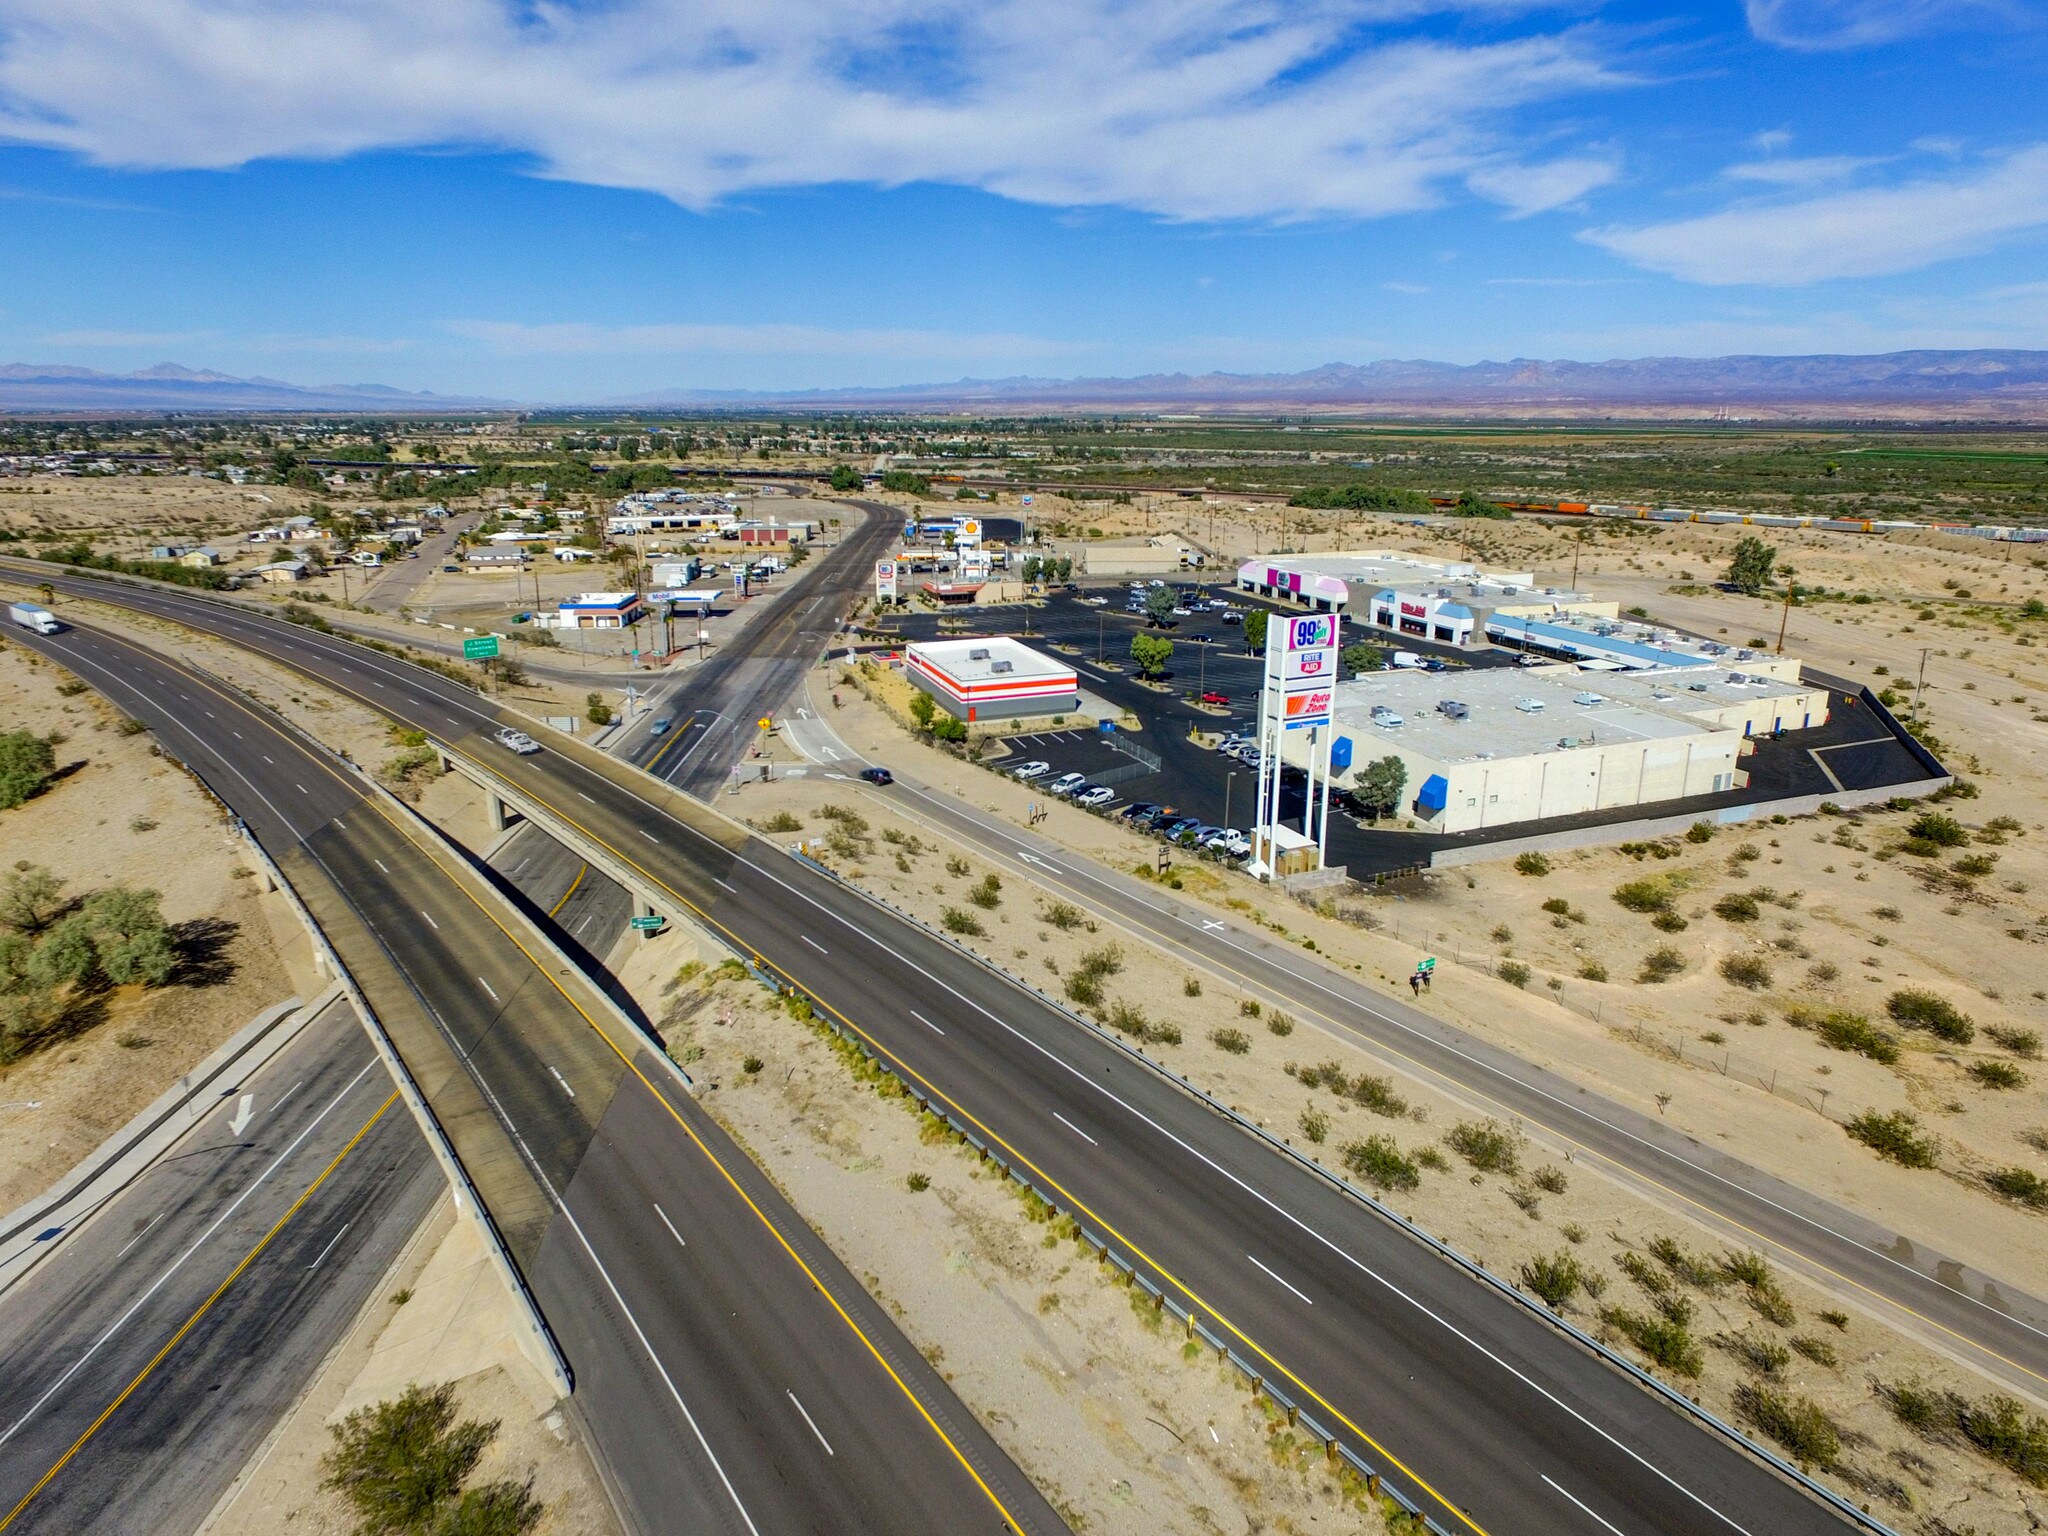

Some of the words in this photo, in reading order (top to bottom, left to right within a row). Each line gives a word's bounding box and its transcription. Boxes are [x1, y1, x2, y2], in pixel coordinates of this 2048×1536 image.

[652, 592, 670, 600] Mobil
[1303, 653, 1320, 662] RITE
[1304, 663, 1319, 671] AID
[1310, 693, 1331, 703] Auto
[1305, 703, 1327, 713] Zone
